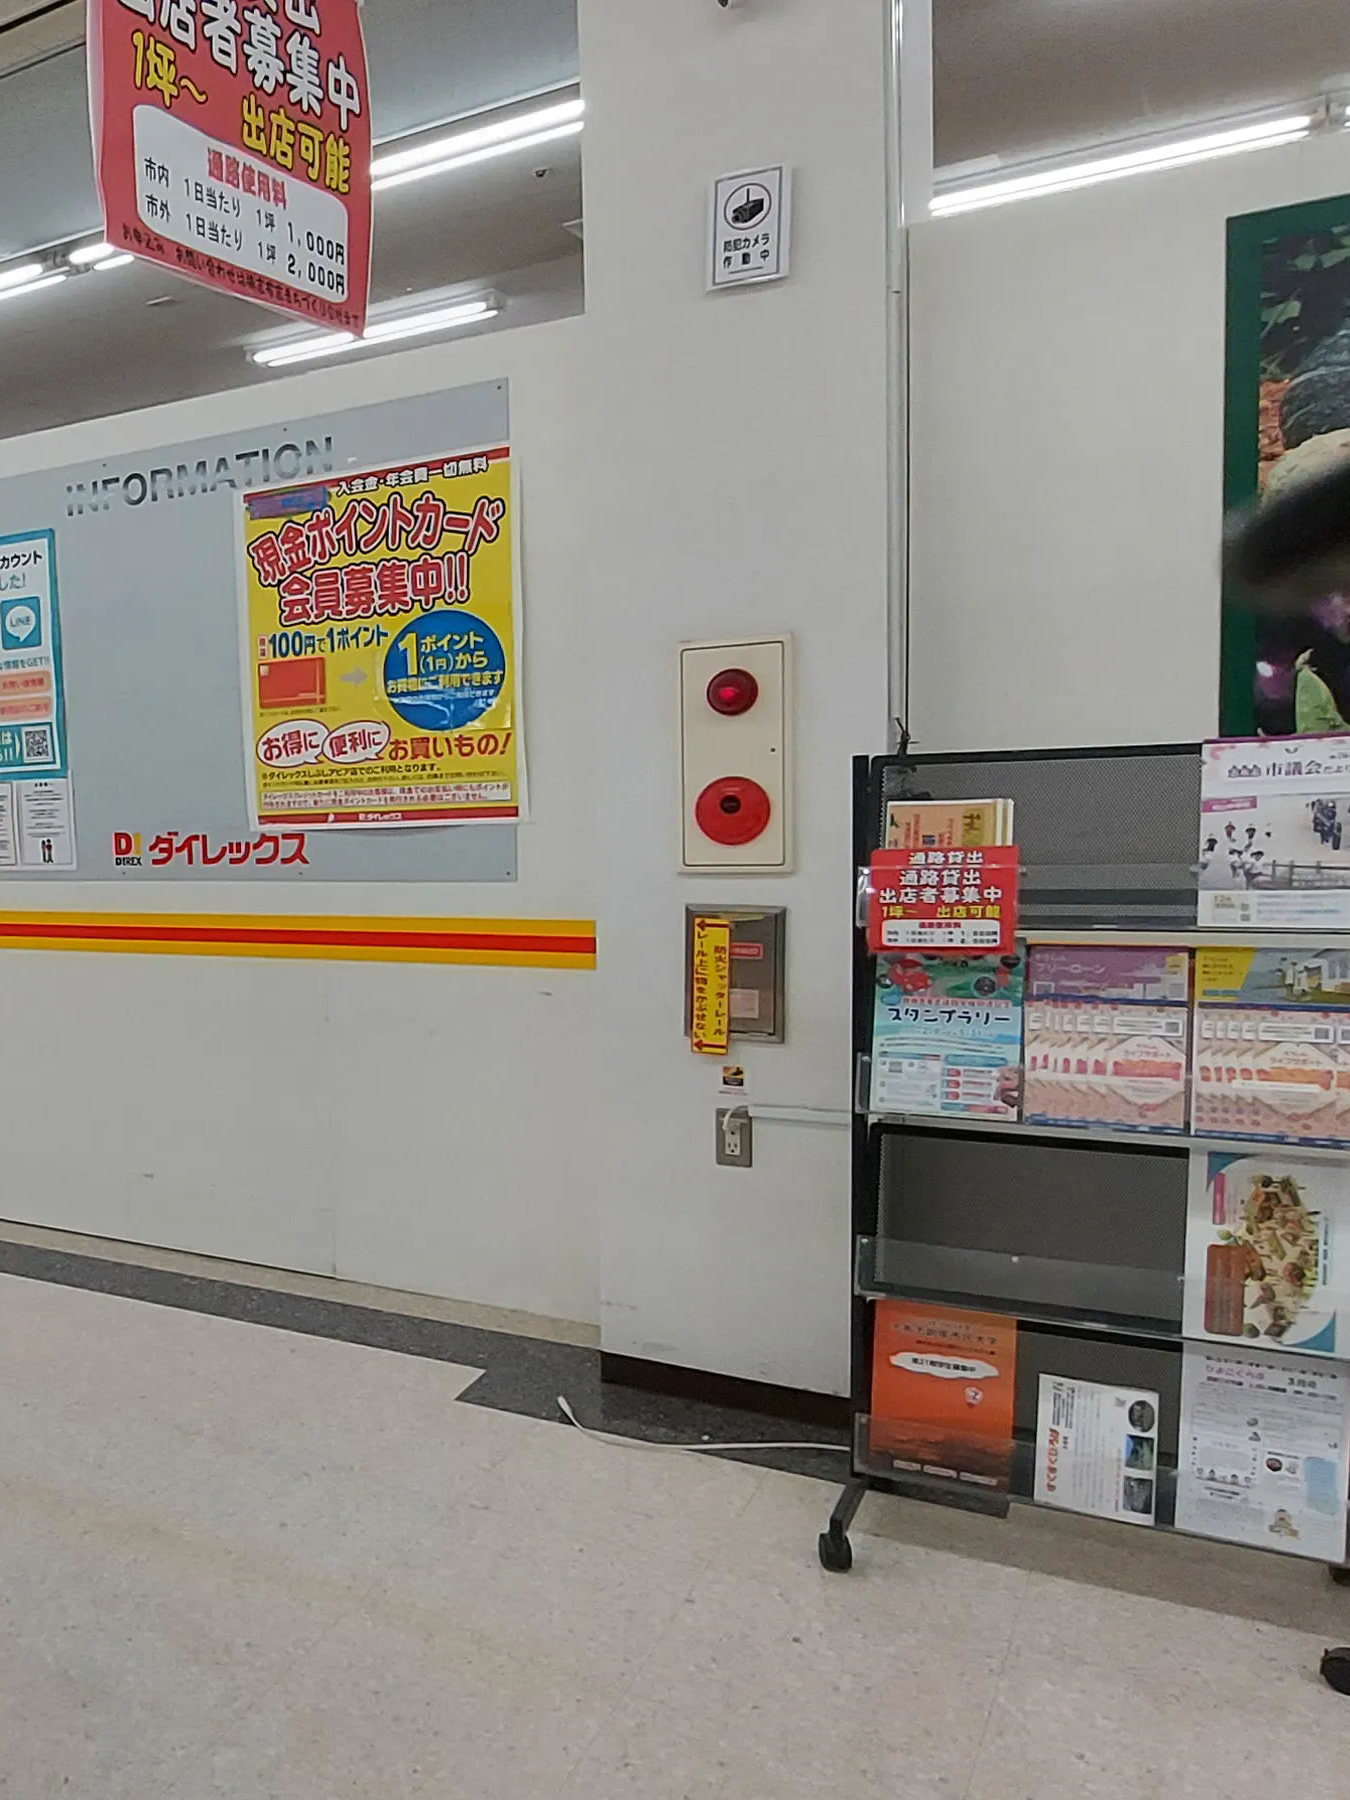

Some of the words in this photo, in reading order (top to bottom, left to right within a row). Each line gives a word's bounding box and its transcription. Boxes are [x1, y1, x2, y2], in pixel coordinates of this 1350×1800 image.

[242, 93, 351, 193] 出店可能
[207, 147, 287, 210] 通路使用料
[144, 157, 171, 188] 市内
[184, 178, 241, 218] 1日当たり
[256, 208, 276, 233] 1坪
[287, 221, 345, 266] 1,000円
[145, 193, 172, 224] 市外
[185, 212, 243, 251] 1日当たり
[257, 239, 277, 266] 1坪
[287, 251, 345, 296] 2,000円
[66, 436, 333, 516] INFORMATION
[249, 490, 505, 586] 現金ポイントカード
[279, 551, 469, 627] 会員募集中!!
[10, 616, 31, 628] LINE
[421, 631, 484, 652] ポイント
[262, 730, 320, 761] お得に
[329, 728, 383, 759] 便利に
[389, 732, 512, 761] お買いもの!
[149, 831, 310, 866] ダイレックス
[879, 885, 1003, 904] 出店者募集中
[899, 868, 982, 886] 通路貸出
[936, 905, 1001, 918] 出店可能
[1035, 962, 1107, 974] フリーローン
[713, 945, 727, 1036] 防火シャッターレール
[888, 1007, 1011, 1025] スタンプラリー
